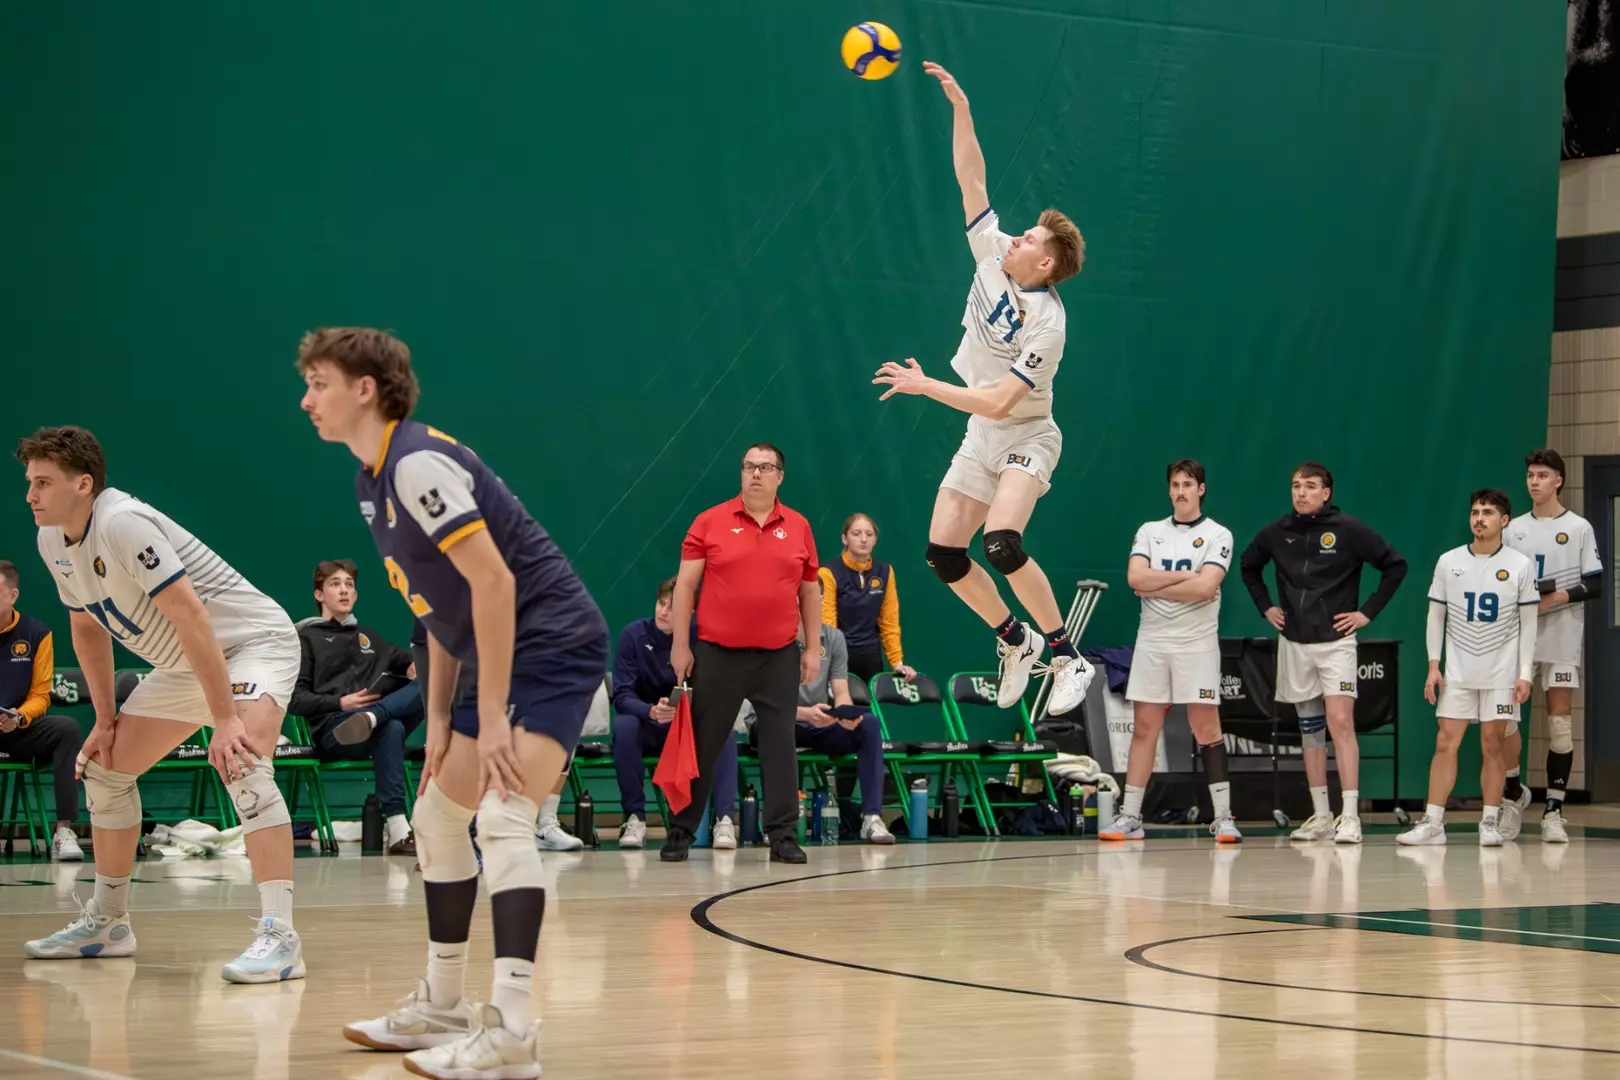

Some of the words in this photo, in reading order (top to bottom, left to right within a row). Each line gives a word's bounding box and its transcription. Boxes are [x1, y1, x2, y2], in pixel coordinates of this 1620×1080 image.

[1464, 591, 1500, 622] 19
[1358, 662, 1384, 680] orts
[1220, 685, 1241, 696] ART
